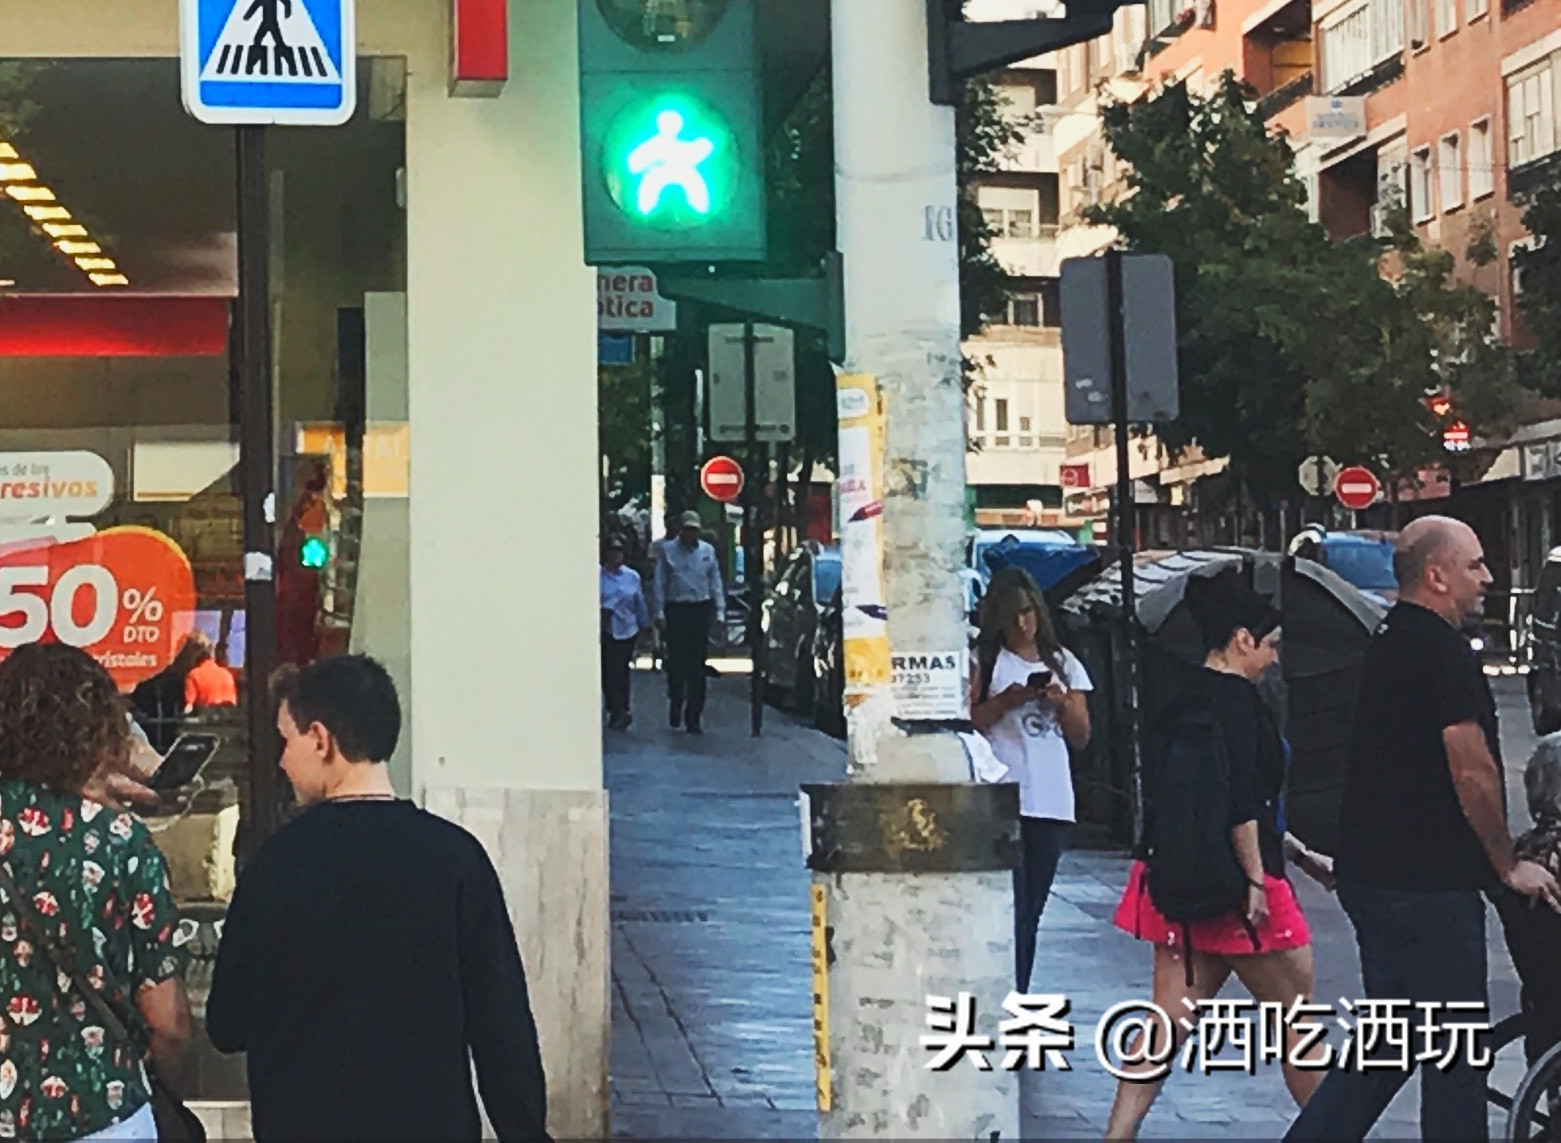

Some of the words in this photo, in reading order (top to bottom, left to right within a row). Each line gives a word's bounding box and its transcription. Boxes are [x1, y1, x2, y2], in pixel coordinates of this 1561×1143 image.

[123, 625, 161, 644] DTO
[93, 651, 158, 669] ristales
[891, 656, 957, 670] RMAS
